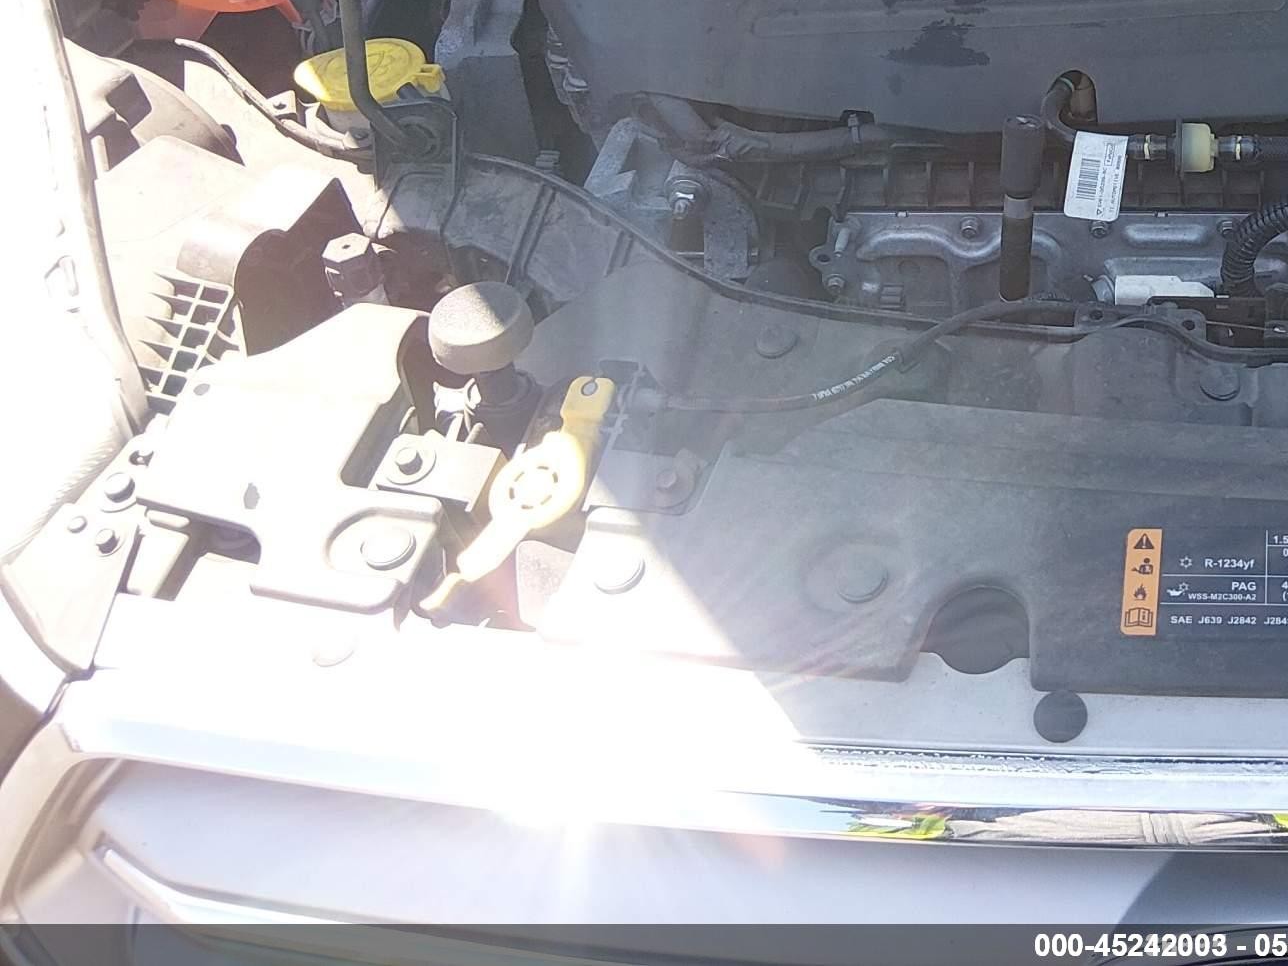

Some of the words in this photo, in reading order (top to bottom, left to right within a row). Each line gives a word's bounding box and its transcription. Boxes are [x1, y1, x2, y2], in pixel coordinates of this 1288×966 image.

[1204, 558, 1255, 571] R-1234yf
[1231, 581, 1257, 591] PAG
[1170, 615, 1193, 624] SAE
[1198, 615, 1223, 625] J639
[1227, 616, 1257, 625] J2842
